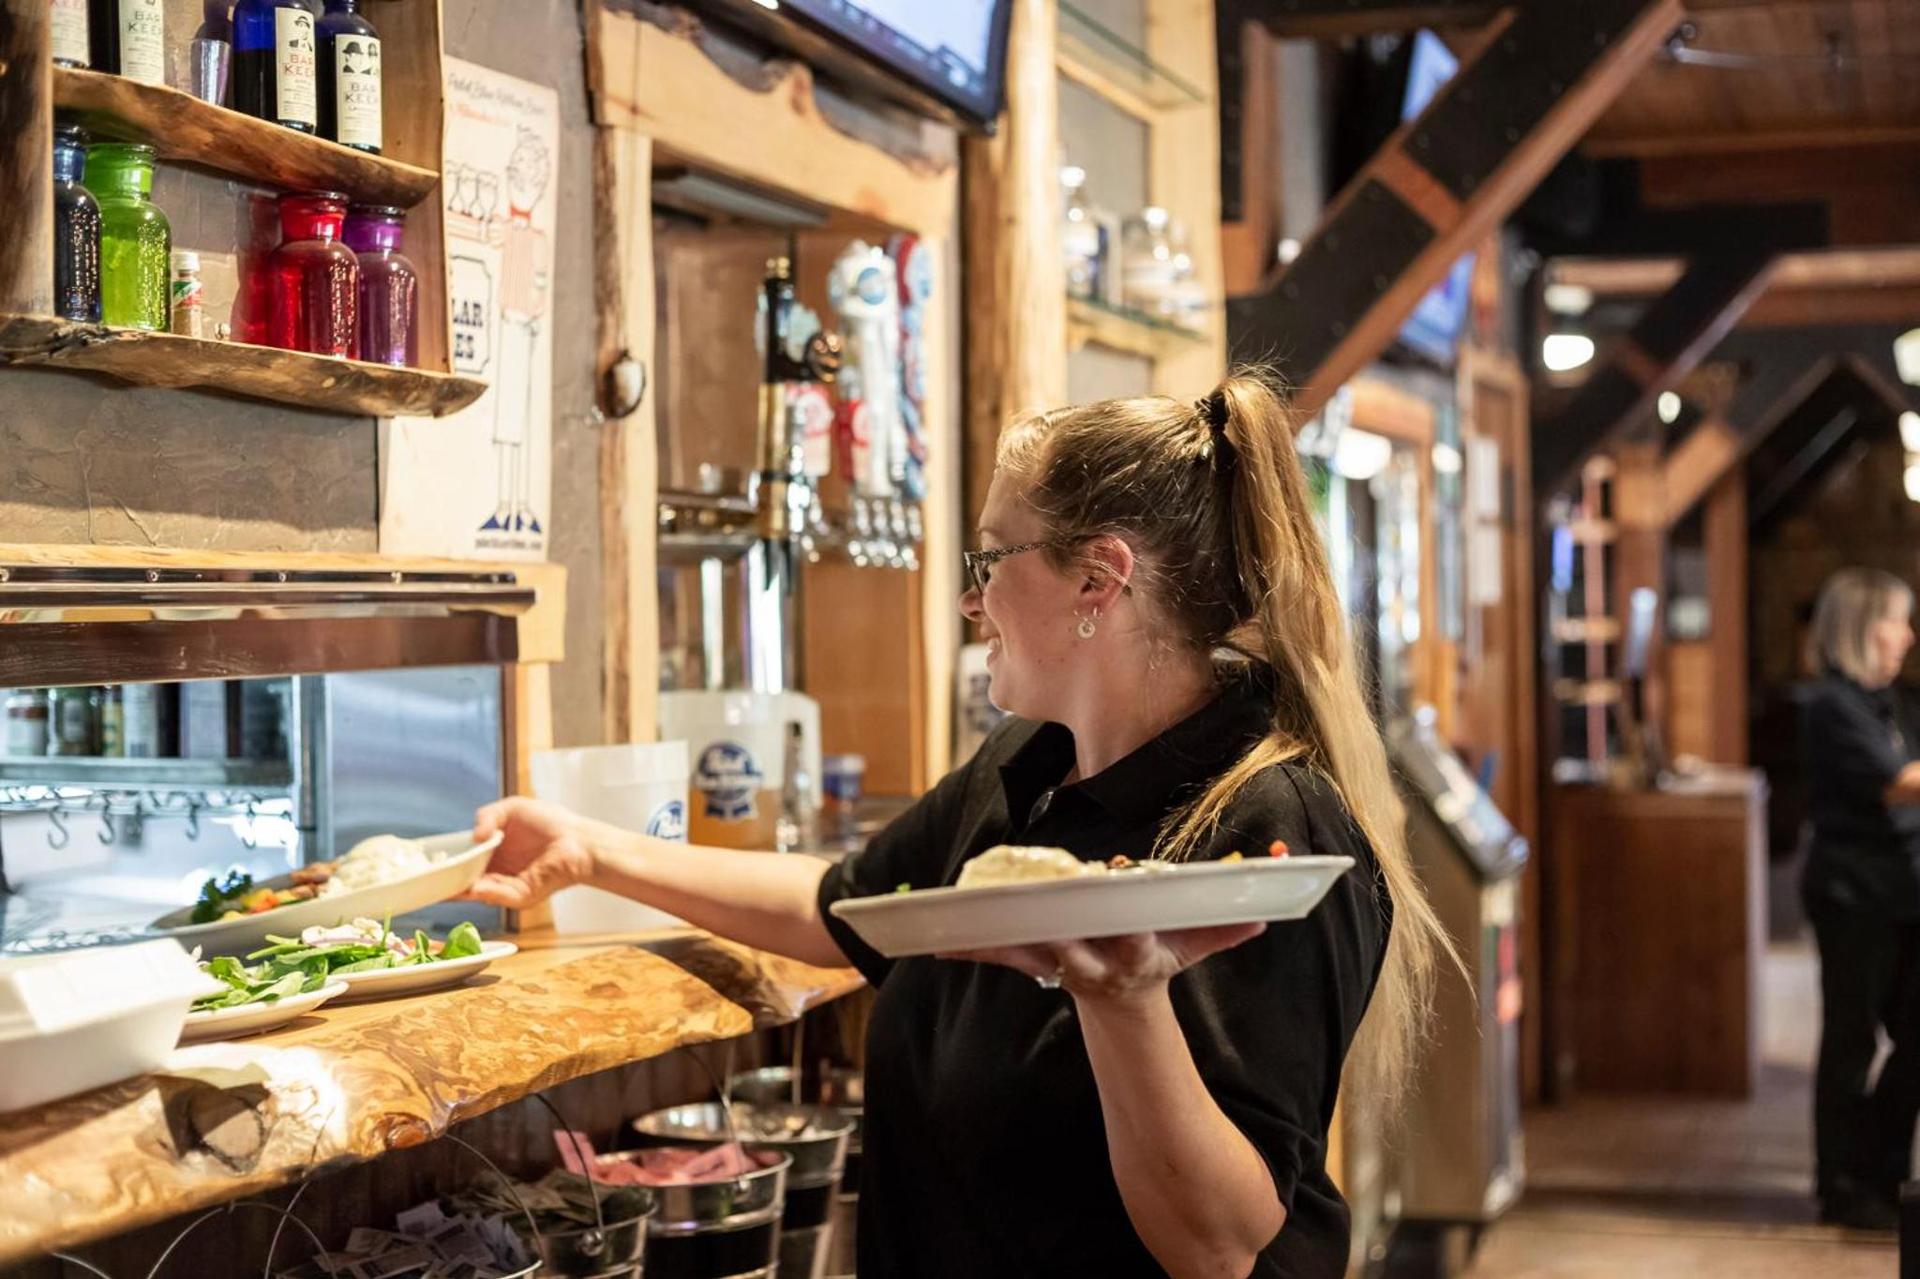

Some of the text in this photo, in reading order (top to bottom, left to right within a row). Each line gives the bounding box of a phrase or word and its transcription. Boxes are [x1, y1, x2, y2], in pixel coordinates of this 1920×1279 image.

[128, 22, 161, 35] KEE
[284, 64, 315, 77] KEE
[344, 93, 378, 104] KEE
